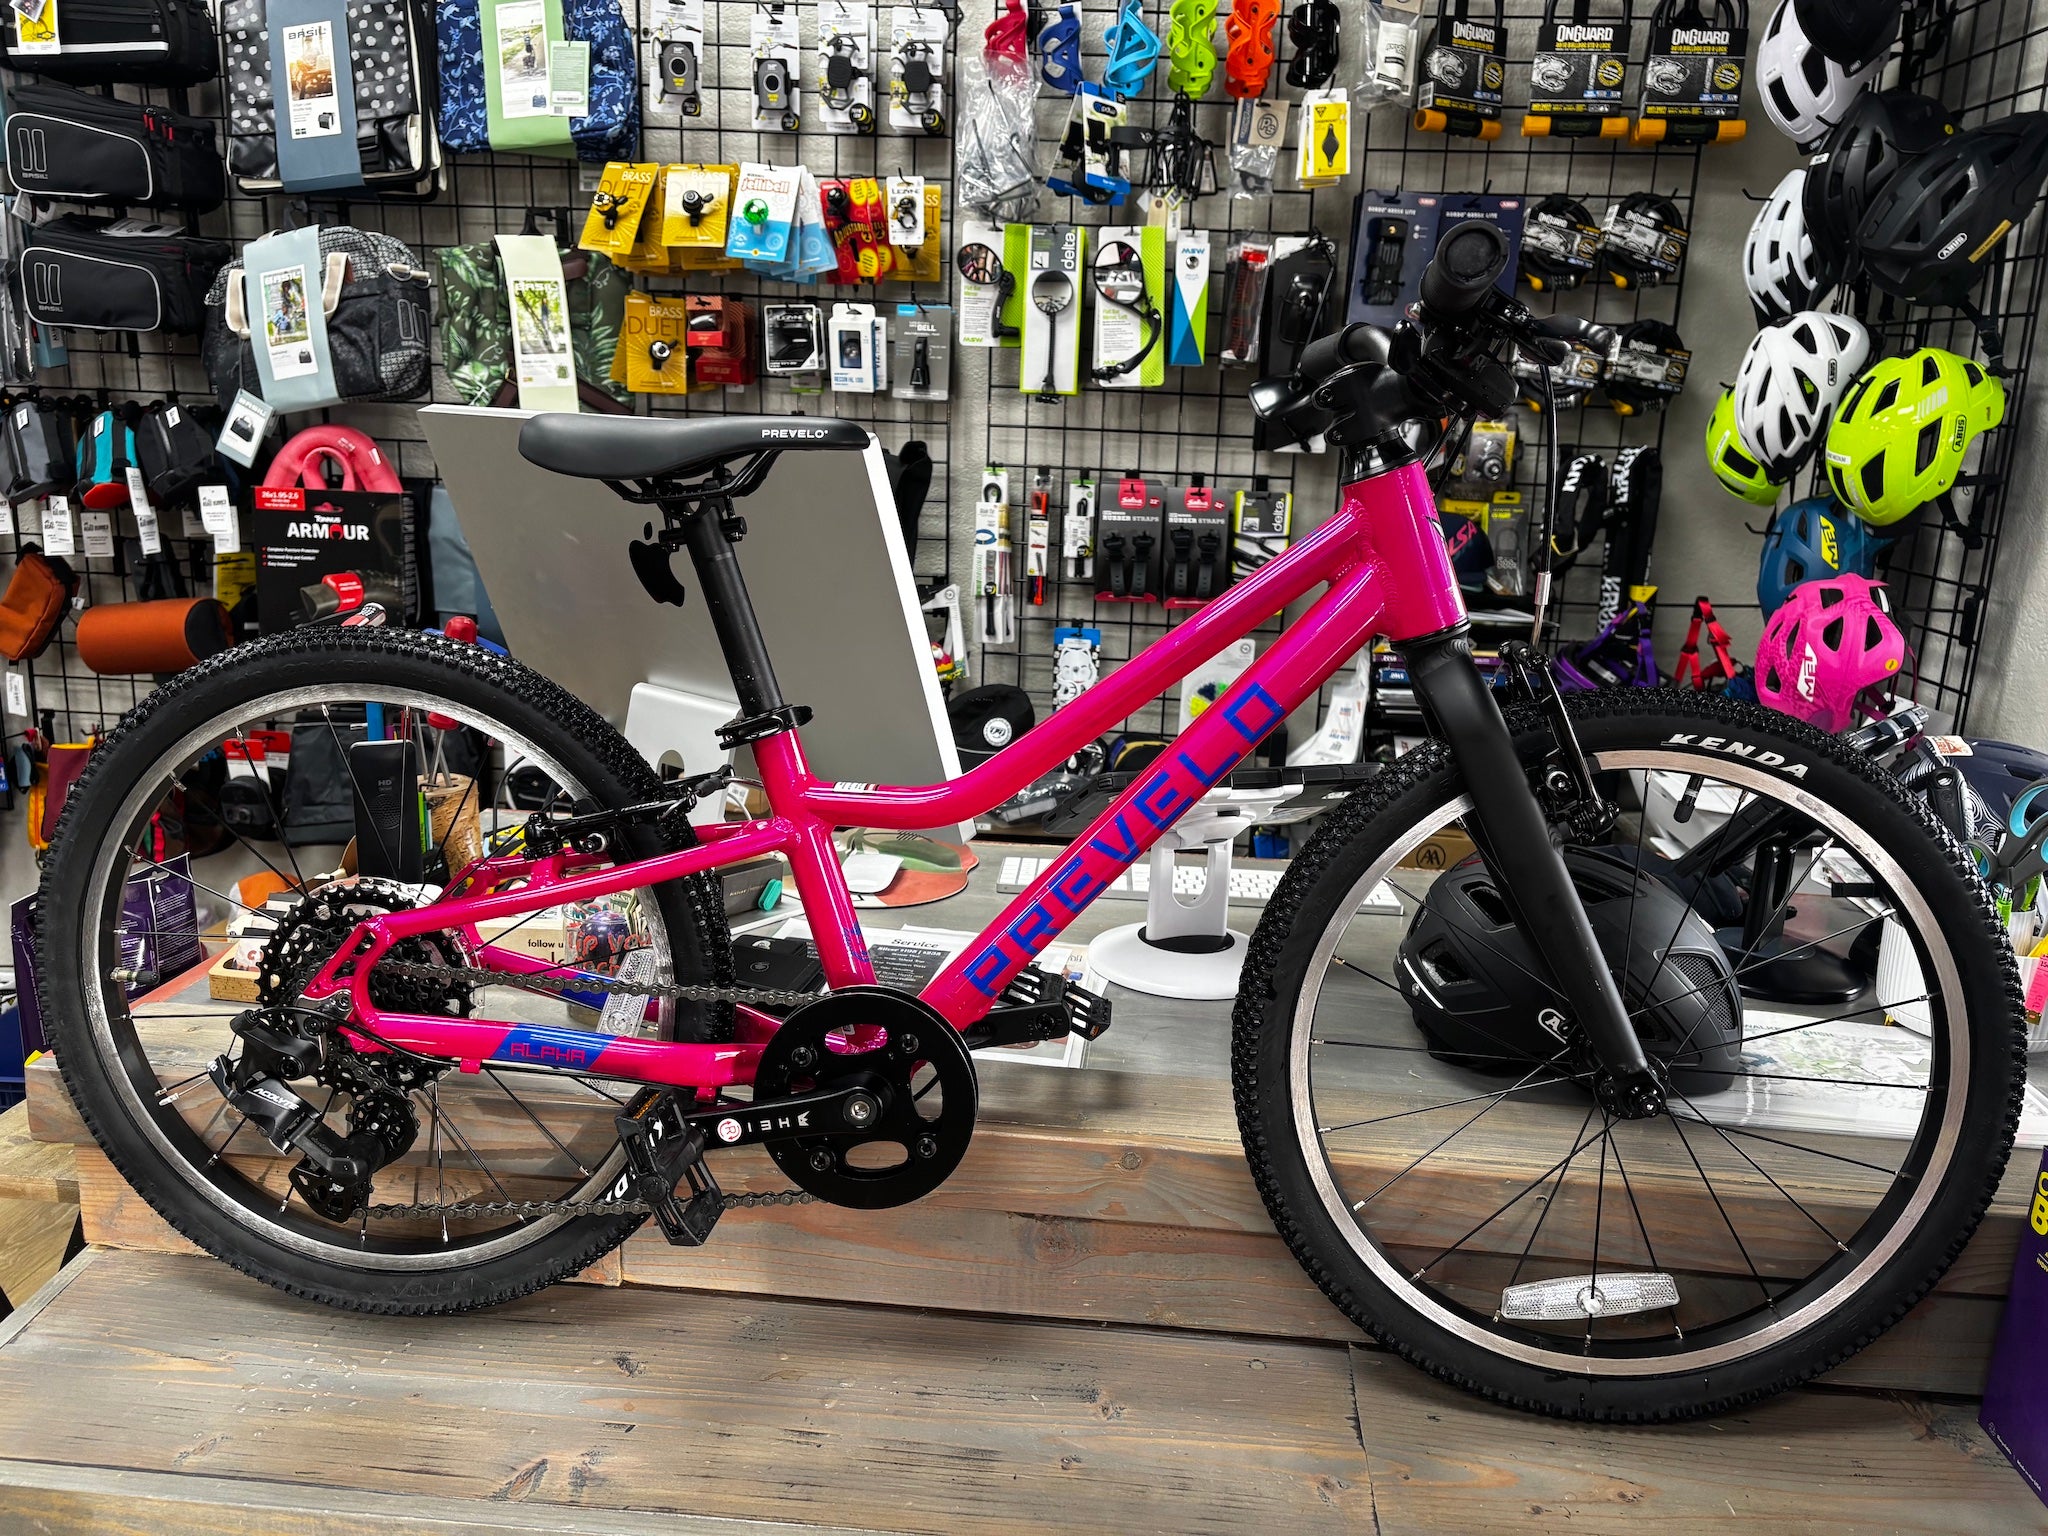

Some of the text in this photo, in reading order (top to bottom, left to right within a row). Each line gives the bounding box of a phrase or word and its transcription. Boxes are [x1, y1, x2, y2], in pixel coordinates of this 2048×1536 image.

[621, 170, 652, 184] BRASS
[741, 176, 791, 195] jellibell
[1060, 232, 1076, 270] delta
[649, 305, 683, 319] BRASS
[627, 315, 683, 337] DUET
[761, 429, 825, 439] PREVELO
[1955, 416, 1966, 449] ABUS
[1272, 502, 1286, 532] delta
[286, 521, 371, 542] ARMOUR
[1449, 521, 1478, 557] LSA
[1665, 733, 1810, 781] KENDA
[963, 681, 1287, 999] PREVELO
[527, 938, 556, 949] follow
[891, 938, 940, 949] Service
[509, 1041, 586, 1065] ALPHA
[252, 1087, 301, 1112] ACOLYTE
